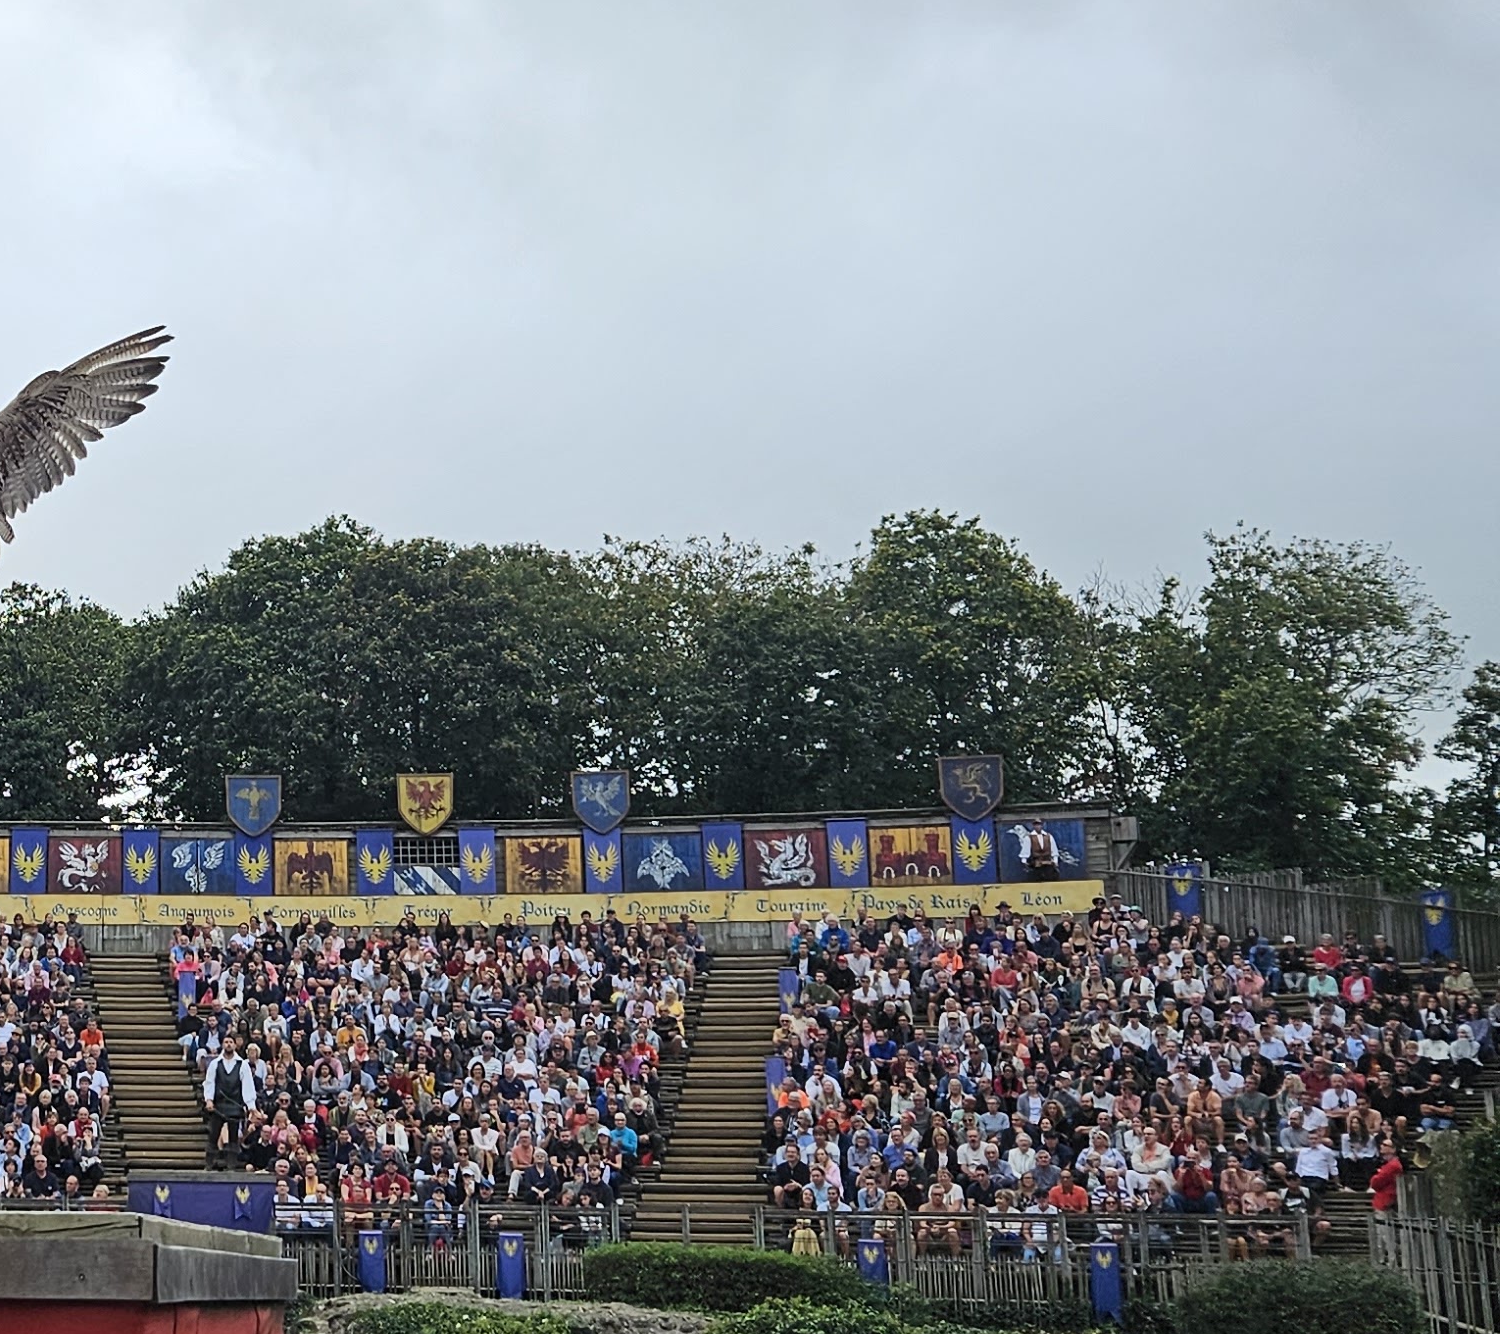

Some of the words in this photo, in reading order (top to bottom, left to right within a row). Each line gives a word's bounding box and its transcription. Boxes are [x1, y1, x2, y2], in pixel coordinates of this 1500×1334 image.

[930, 894, 971, 909] Rais
[1021, 891, 1063, 906] Léon
[52, 902, 118, 921] Gascogne
